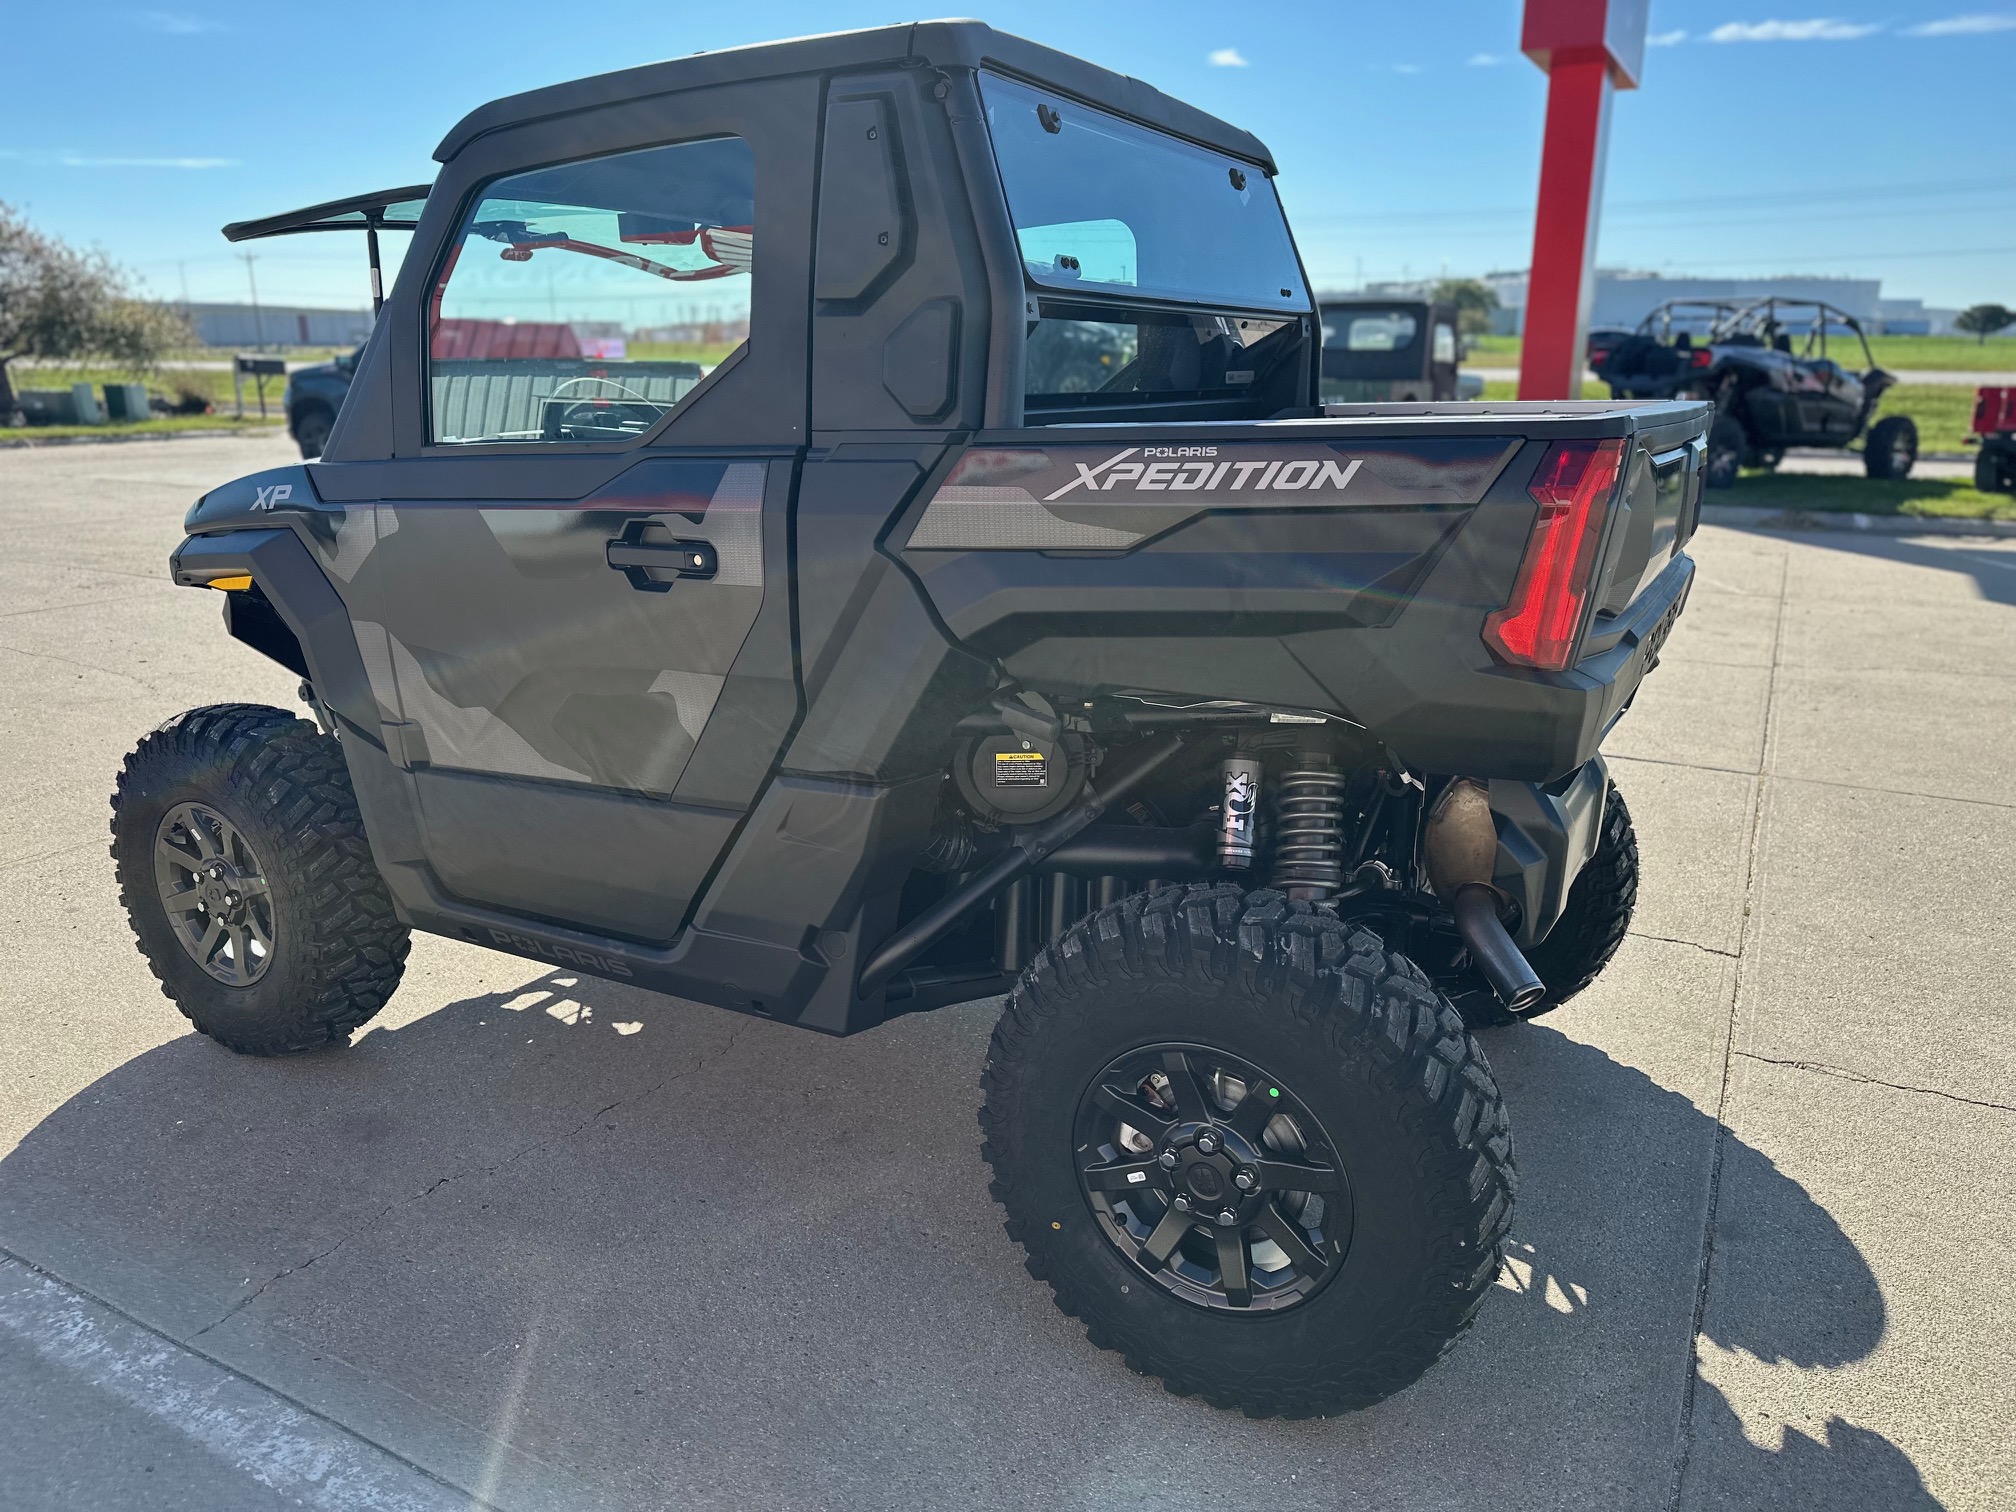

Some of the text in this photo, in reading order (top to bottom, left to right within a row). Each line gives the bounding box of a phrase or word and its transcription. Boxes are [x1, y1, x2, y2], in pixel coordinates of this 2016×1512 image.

[1042, 447, 1364, 500] XPEDITION
[1144, 446, 1218, 458] POLARIS
[249, 484, 293, 511] XP
[1223, 771, 1259, 831] FOX
[487, 928, 634, 977] POLARIS
